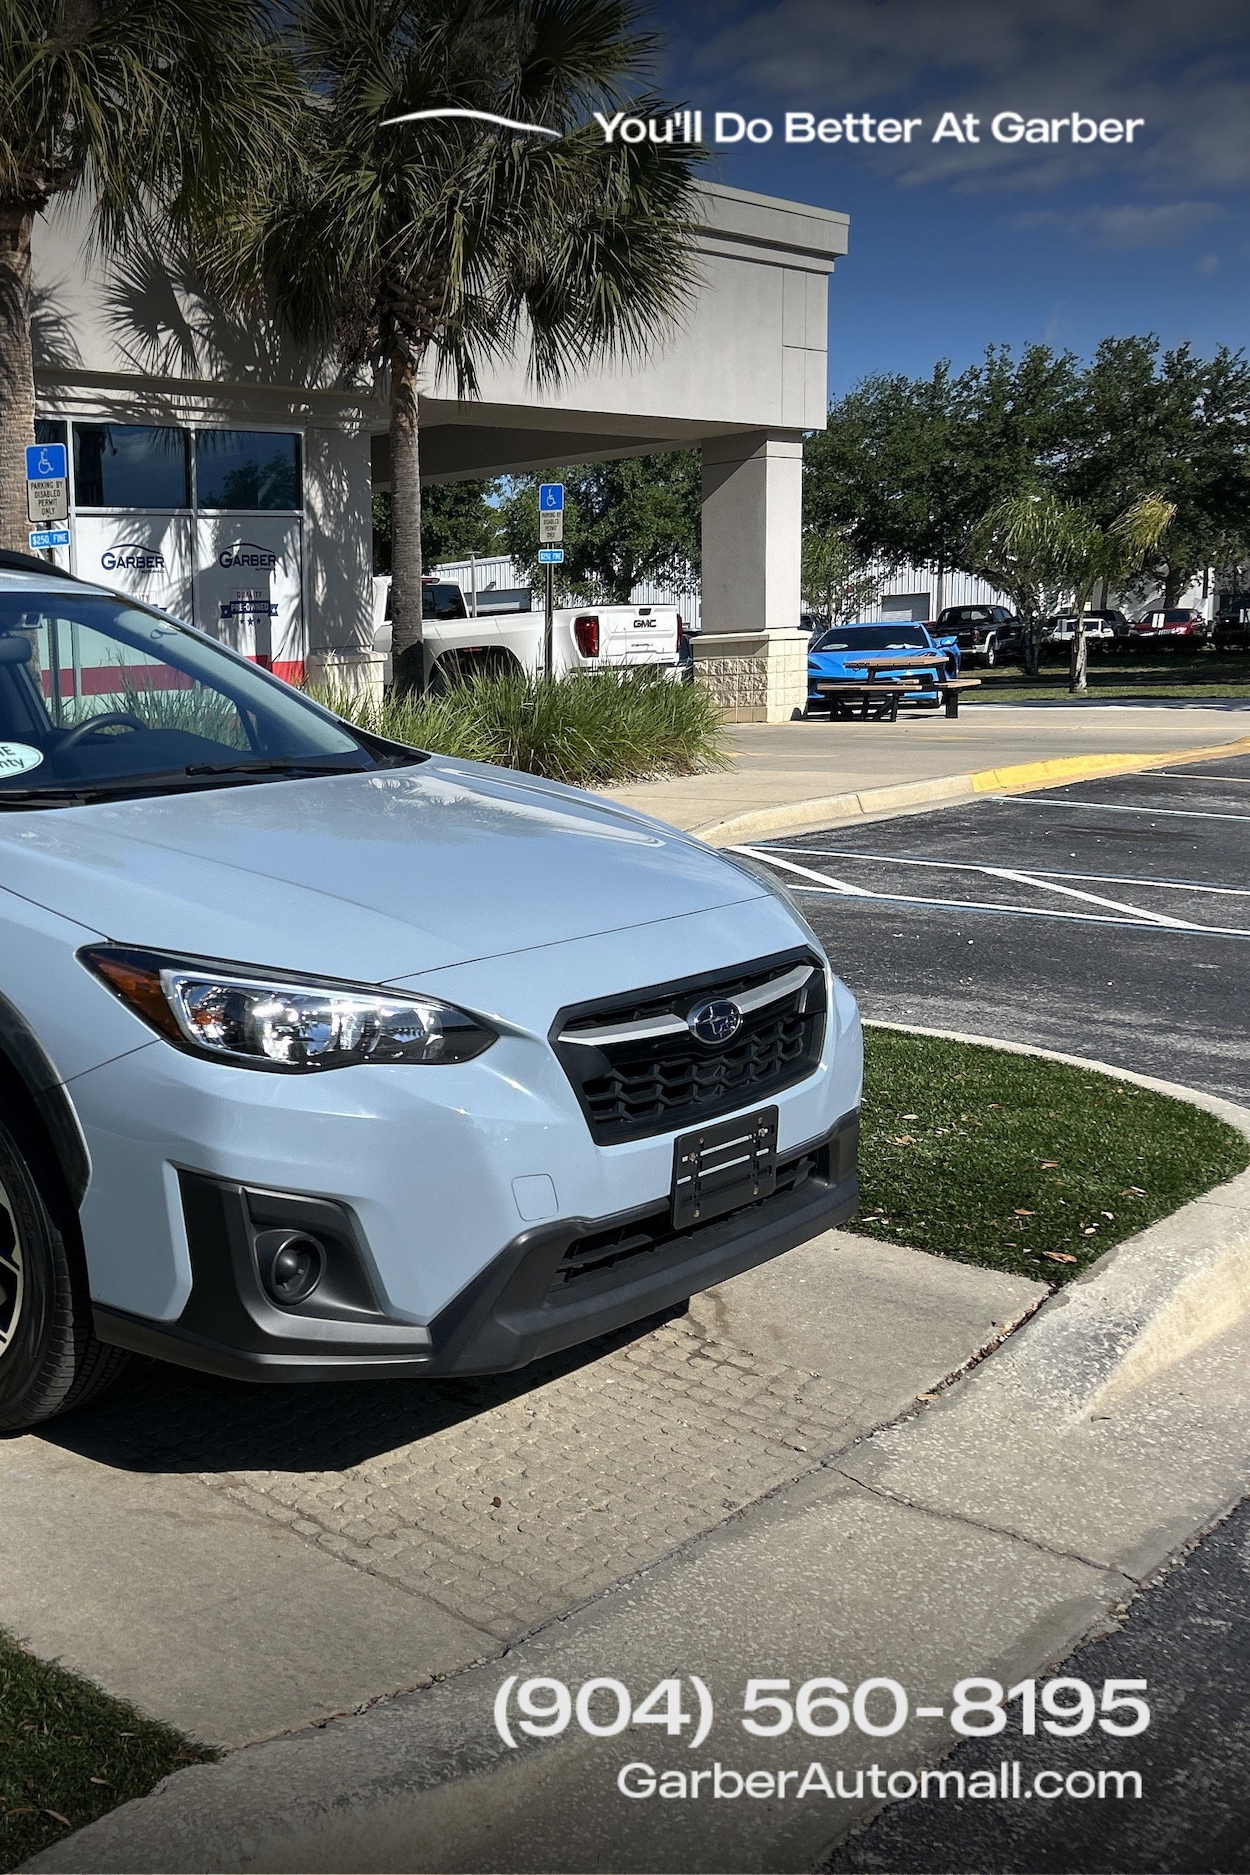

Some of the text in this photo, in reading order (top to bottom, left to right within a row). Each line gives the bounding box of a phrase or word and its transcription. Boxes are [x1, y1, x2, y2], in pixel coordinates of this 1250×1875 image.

[30, 481, 54, 490] PARKING
[34, 489, 61, 499] DISABLED
[38, 498, 58, 507] PERMIT
[41, 507, 56, 516] ONLY
[32, 532, 68, 546] $250 FINE
[101, 552, 165, 571] GARBER
[219, 551, 277, 569] GARBER
[633, 619, 657, 628] GMC
